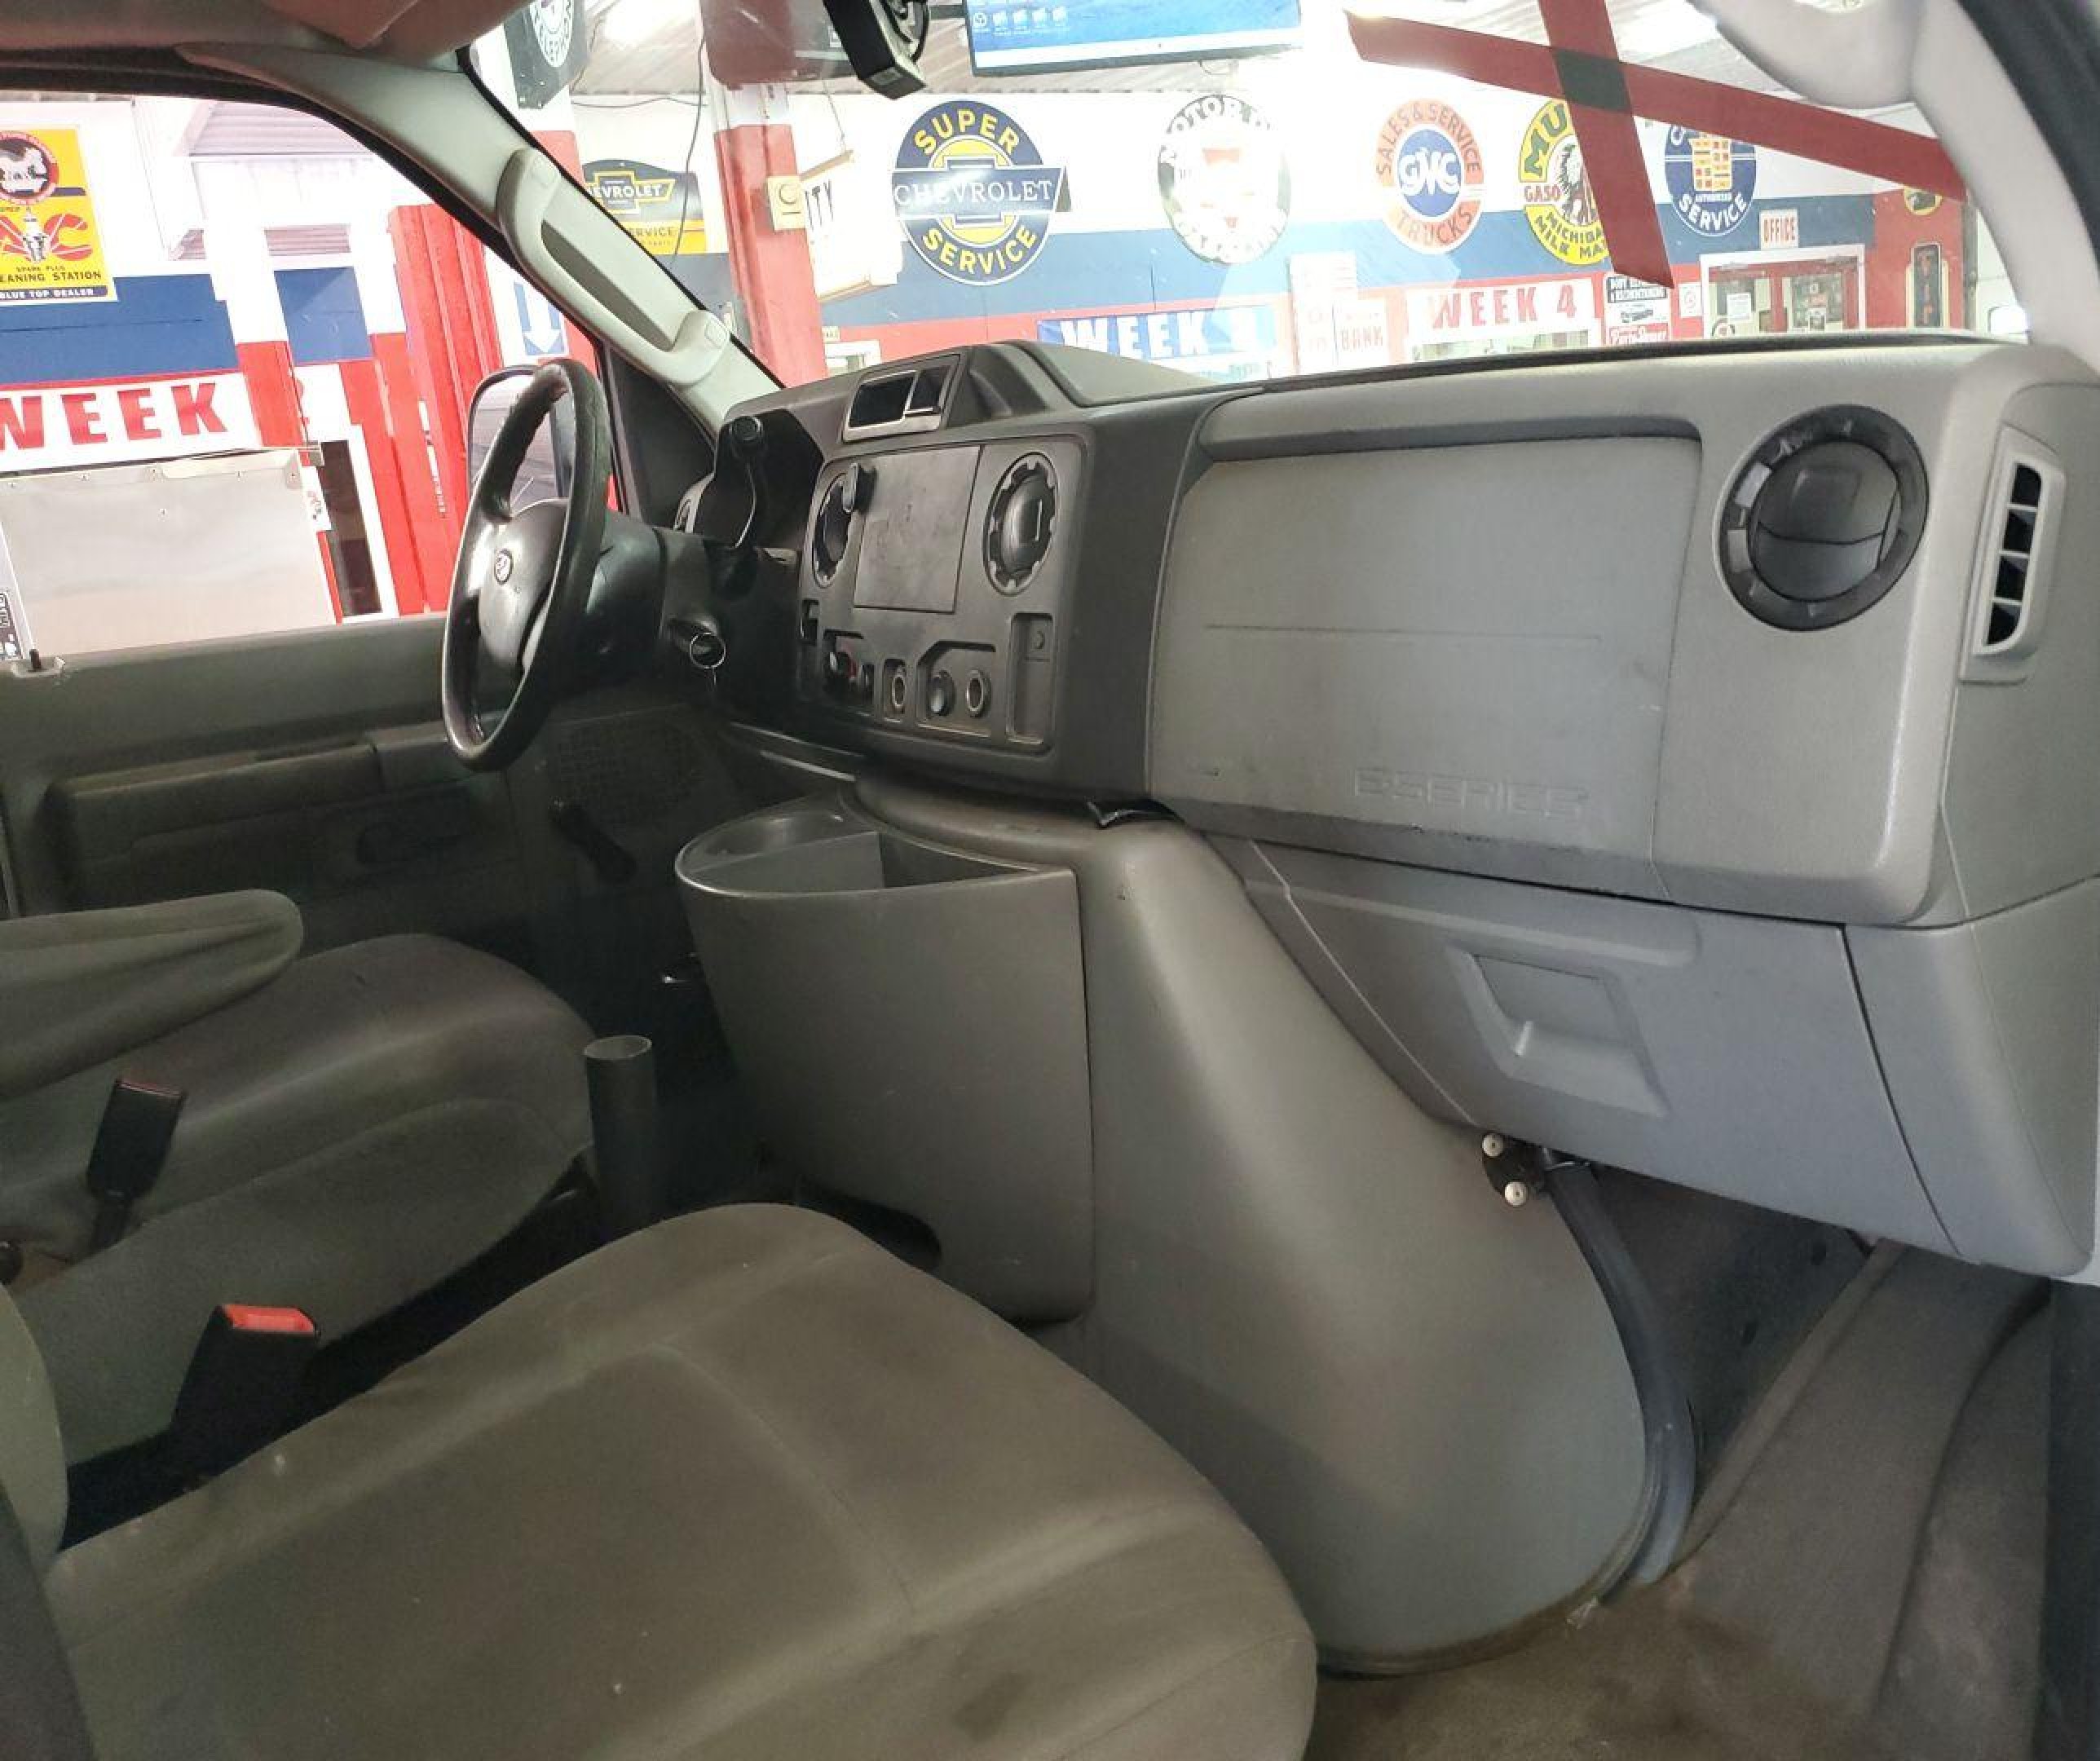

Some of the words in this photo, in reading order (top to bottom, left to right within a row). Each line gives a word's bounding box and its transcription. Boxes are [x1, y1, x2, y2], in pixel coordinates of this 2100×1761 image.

[914, 108, 1020, 154] SUPER
[1428, 103, 1482, 173] SERVICE
[586, 183, 661, 198] EVROLET
[894, 180, 1052, 205] CHEVROLET
[1397, 147, 1462, 196] GMC
[1524, 184, 1561, 202] GASO
[1393, 203, 1473, 245] TRUCKS
[1679, 192, 1747, 230] SERVICE
[1763, 218, 1796, 243] OFFICE
[922, 225, 1036, 275] SERVICE
[53, 271, 102, 281] STATION
[1430, 287, 1538, 329] WEEK
[1556, 284, 1577, 319] 4
[1059, 310, 1210, 360] WEEK
[0, 382, 228, 451] WEEK
